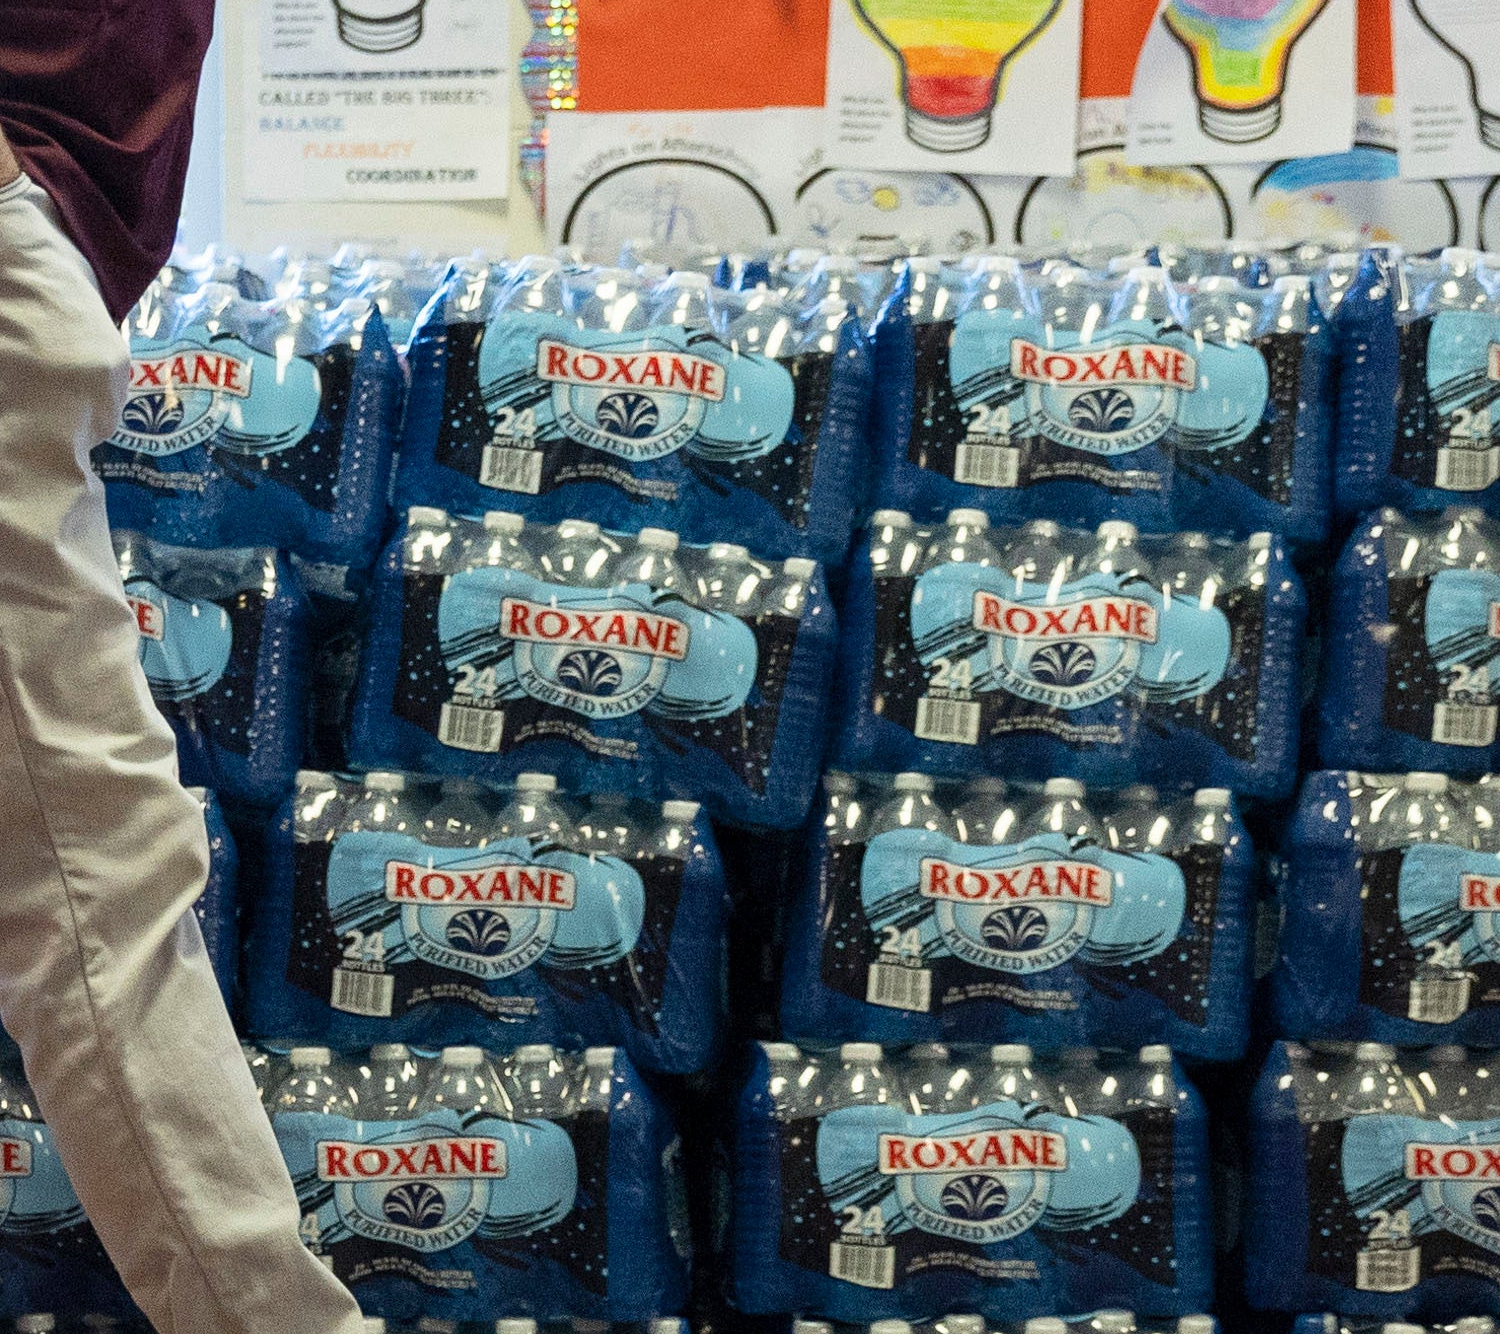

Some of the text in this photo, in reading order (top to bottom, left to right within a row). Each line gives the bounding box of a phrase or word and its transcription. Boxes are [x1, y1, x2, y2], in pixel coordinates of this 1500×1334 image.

[129, 354, 242, 391] XANE
[547, 346, 716, 395] ROXANE
[1019, 344, 1186, 384] ROXANE
[112, 416, 216, 451] IFIED WATER
[496, 408, 535, 435] 24
[970, 406, 1011, 432] 24
[1451, 408, 1491, 436] 24
[636, 424, 691, 458] WATER
[509, 603, 679, 655] ROXANE
[982, 596, 1149, 637] ROXANE
[454, 668, 496, 695] 24
[931, 660, 973, 687] 24
[1450, 666, 1489, 692] 24
[600, 682, 656, 717] WATER
[395, 865, 566, 904] ROXANE
[929, 863, 1102, 901] ROXANE
[344, 931, 385, 958] 24
[488, 935, 547, 975] WATER
[881, 927, 921, 956] 24
[326, 1141, 499, 1177] ROXANE
[887, 1133, 1058, 1170] ROXANE
[428, 1206, 483, 1249] WATER
[843, 1206, 884, 1235] 24
[1369, 1210, 1410, 1238] 24
